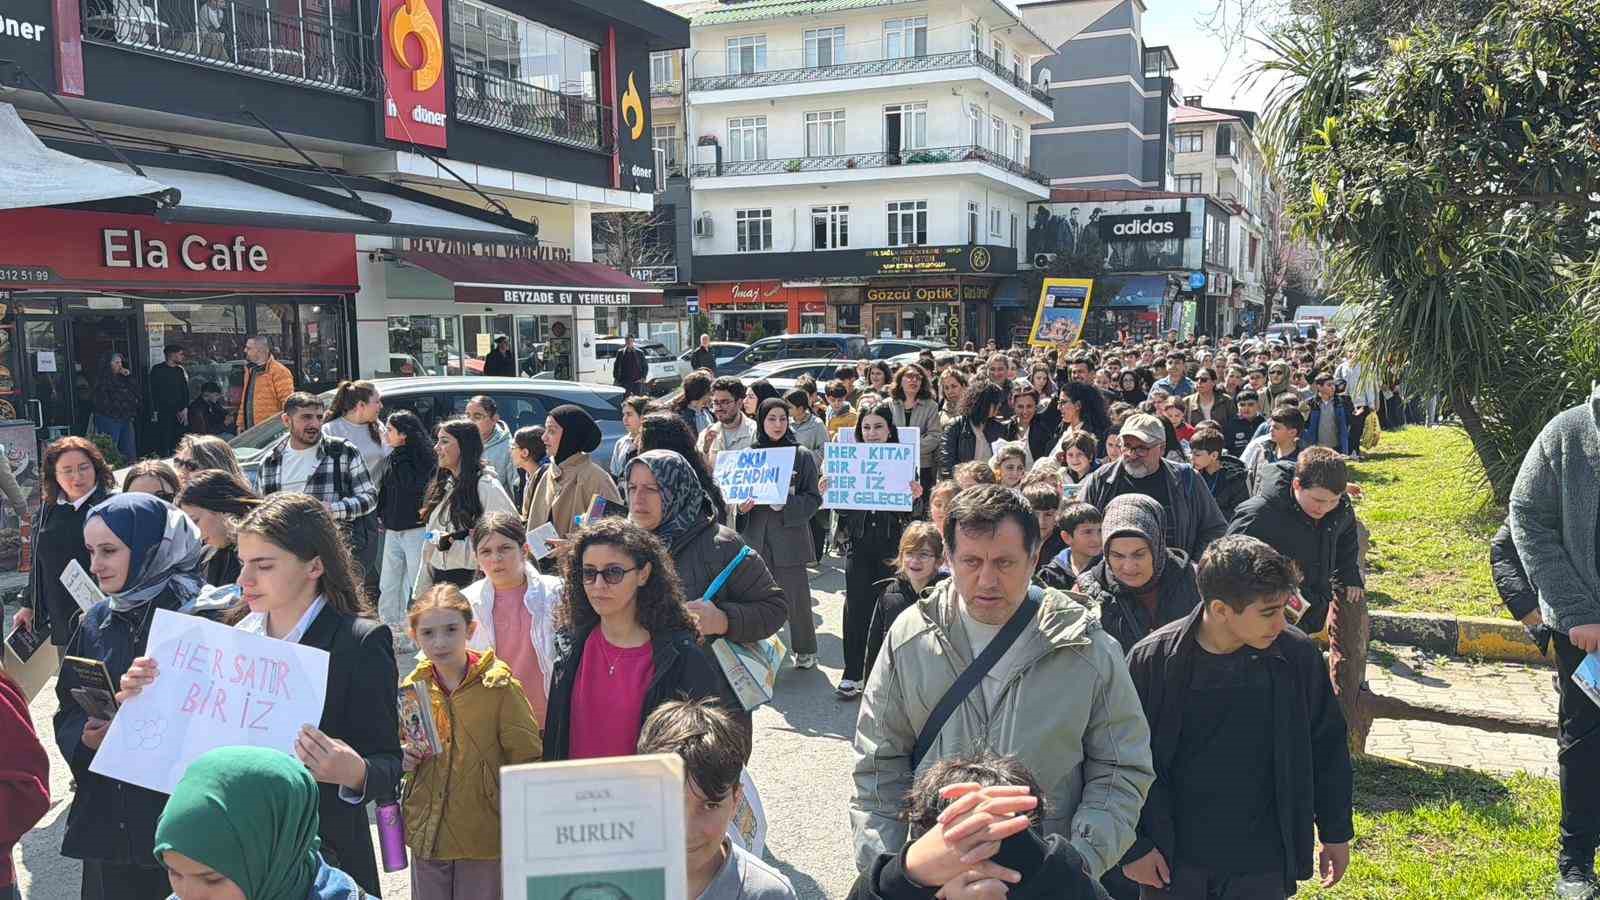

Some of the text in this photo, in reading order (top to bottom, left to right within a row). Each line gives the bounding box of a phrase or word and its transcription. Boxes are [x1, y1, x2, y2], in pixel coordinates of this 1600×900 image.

[1113, 218, 1174, 236] adidas
[103, 229, 269, 272] Ela Cafe
[0, 269, 49, 281] 312 51 99
[503, 289, 631, 305] BEYZADE EV YEMEKLERİ
[916, 287, 953, 302] Optik
[737, 450, 768, 468] OKU
[828, 446, 858, 459] HER
[826, 475, 856, 489] HER
[853, 491, 912, 506] GELECEK
[171, 639, 291, 700] HER SATIR
[180, 680, 275, 731] BİR İZ
[555, 820, 635, 845] BURUN
